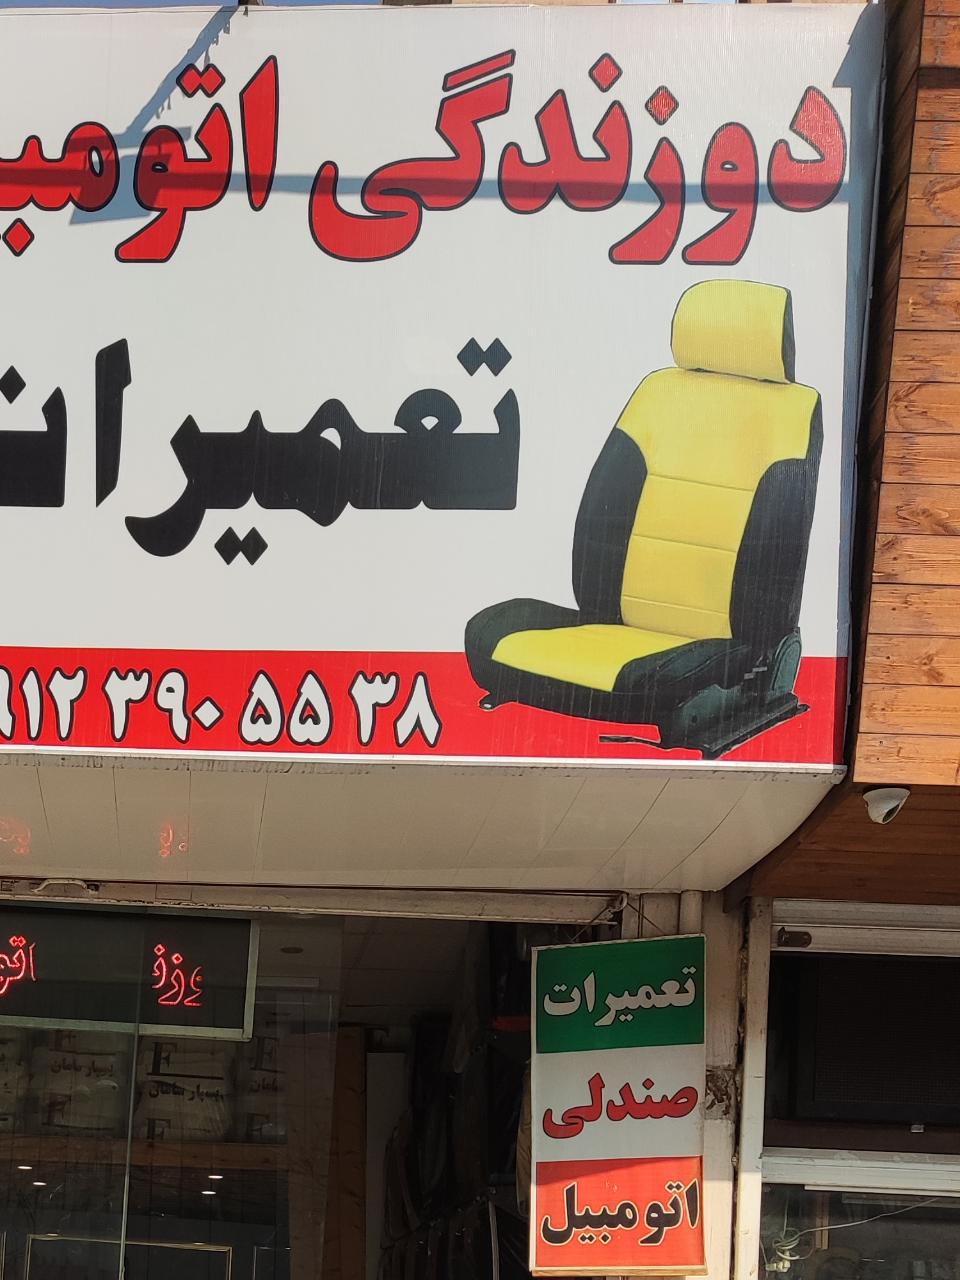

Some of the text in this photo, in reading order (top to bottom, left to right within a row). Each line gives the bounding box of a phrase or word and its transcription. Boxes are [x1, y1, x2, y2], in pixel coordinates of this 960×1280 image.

[308, 49, 849, 265] دوزندگی
[542, 965, 697, 1028] تعمیرات
[542, 1071, 700, 1140] صندلی
[540, 1177, 701, 1247] اتومبیل
